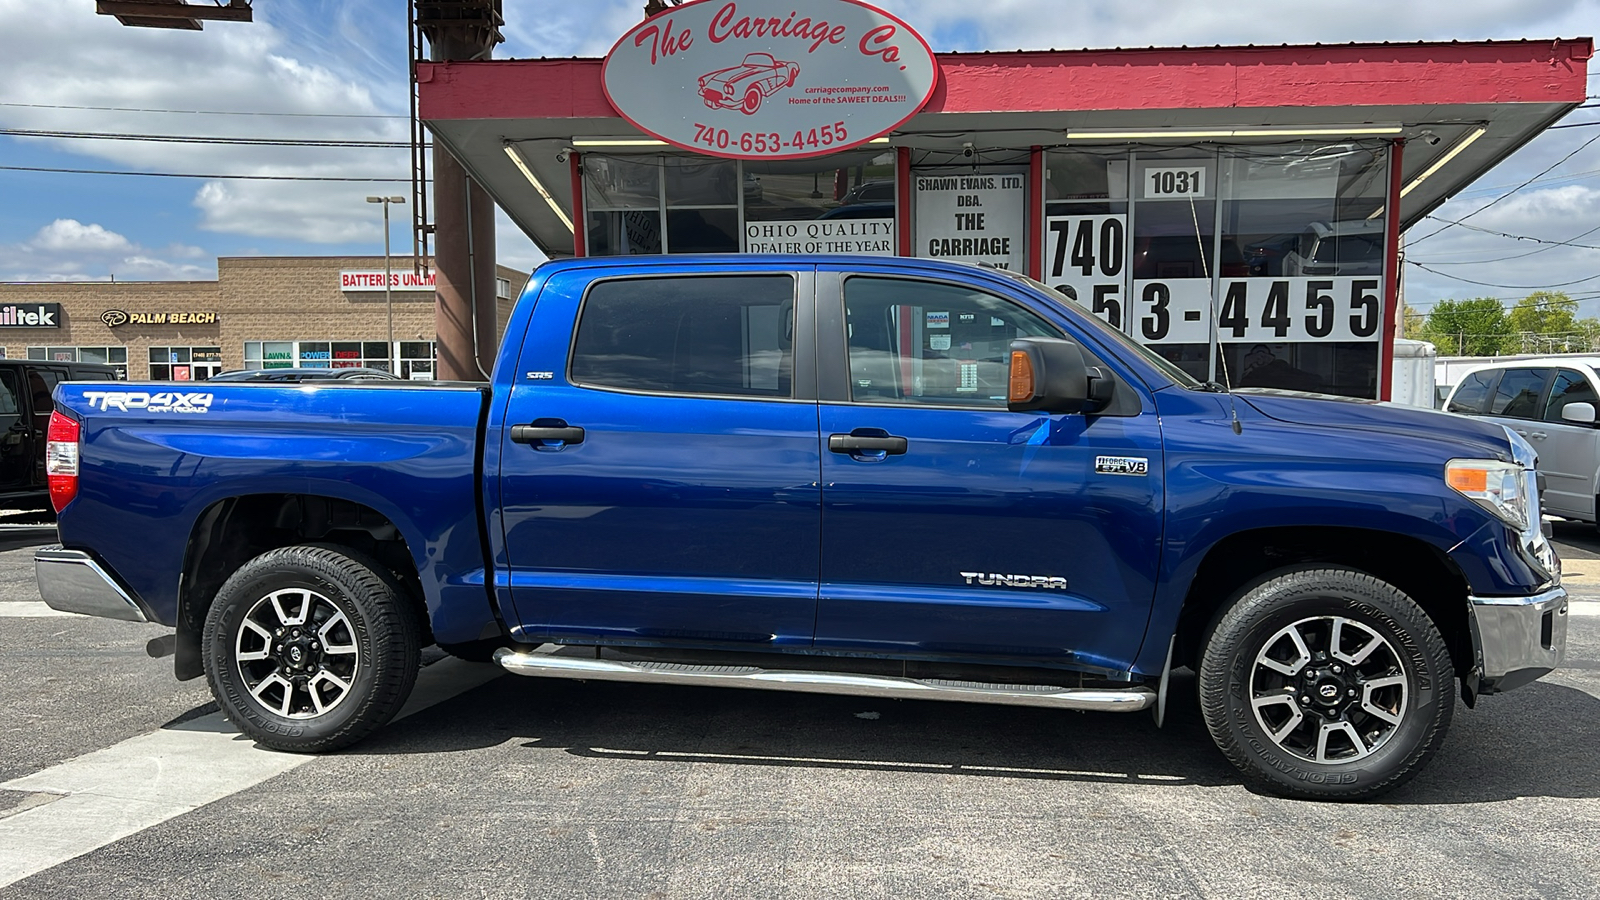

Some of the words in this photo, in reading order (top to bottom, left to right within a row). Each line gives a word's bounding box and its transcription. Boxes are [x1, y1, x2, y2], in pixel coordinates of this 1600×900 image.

[635, 19, 694, 65] The
[708, 2, 846, 53] Carriage
[858, 24, 907, 71] Co.
[805, 86, 889, 95] carriagecompany.com
[837, 96, 870, 104] SAWEET
[872, 95, 906, 103] DEALS!!!
[693, 121, 848, 153] 740-653-4455
[918, 178, 957, 191] SHAWN
[960, 177, 997, 190] EVANS.
[1001, 177, 1023, 189] LTD.
[1151, 171, 1200, 193] 1031
[957, 195, 982, 207] DBA.
[747, 224, 798, 238] OHIO
[806, 222, 893, 239] QUALITY
[955, 213, 985, 231] THE
[751, 243, 802, 253] DEALER
[805, 242, 822, 253] OF
[825, 241, 852, 253] THE
[855, 240, 890, 252] YEAR
[929, 238, 1010, 257] CARRIAGE
[1049, 218, 1124, 277] 740
[129, 313, 167, 324] PALM
[170, 312, 216, 324] BEACH
[335, 351, 359, 359] DEEP
[526, 371, 553, 379] SR5
[83, 391, 150, 412] TRD
[1128, 461, 1146, 472] V8
[960, 571, 1067, 590] TUNDRA
[1342, 596, 1431, 690] YOKOHAMA
[1233, 707, 1360, 784] GEOLANDAR
